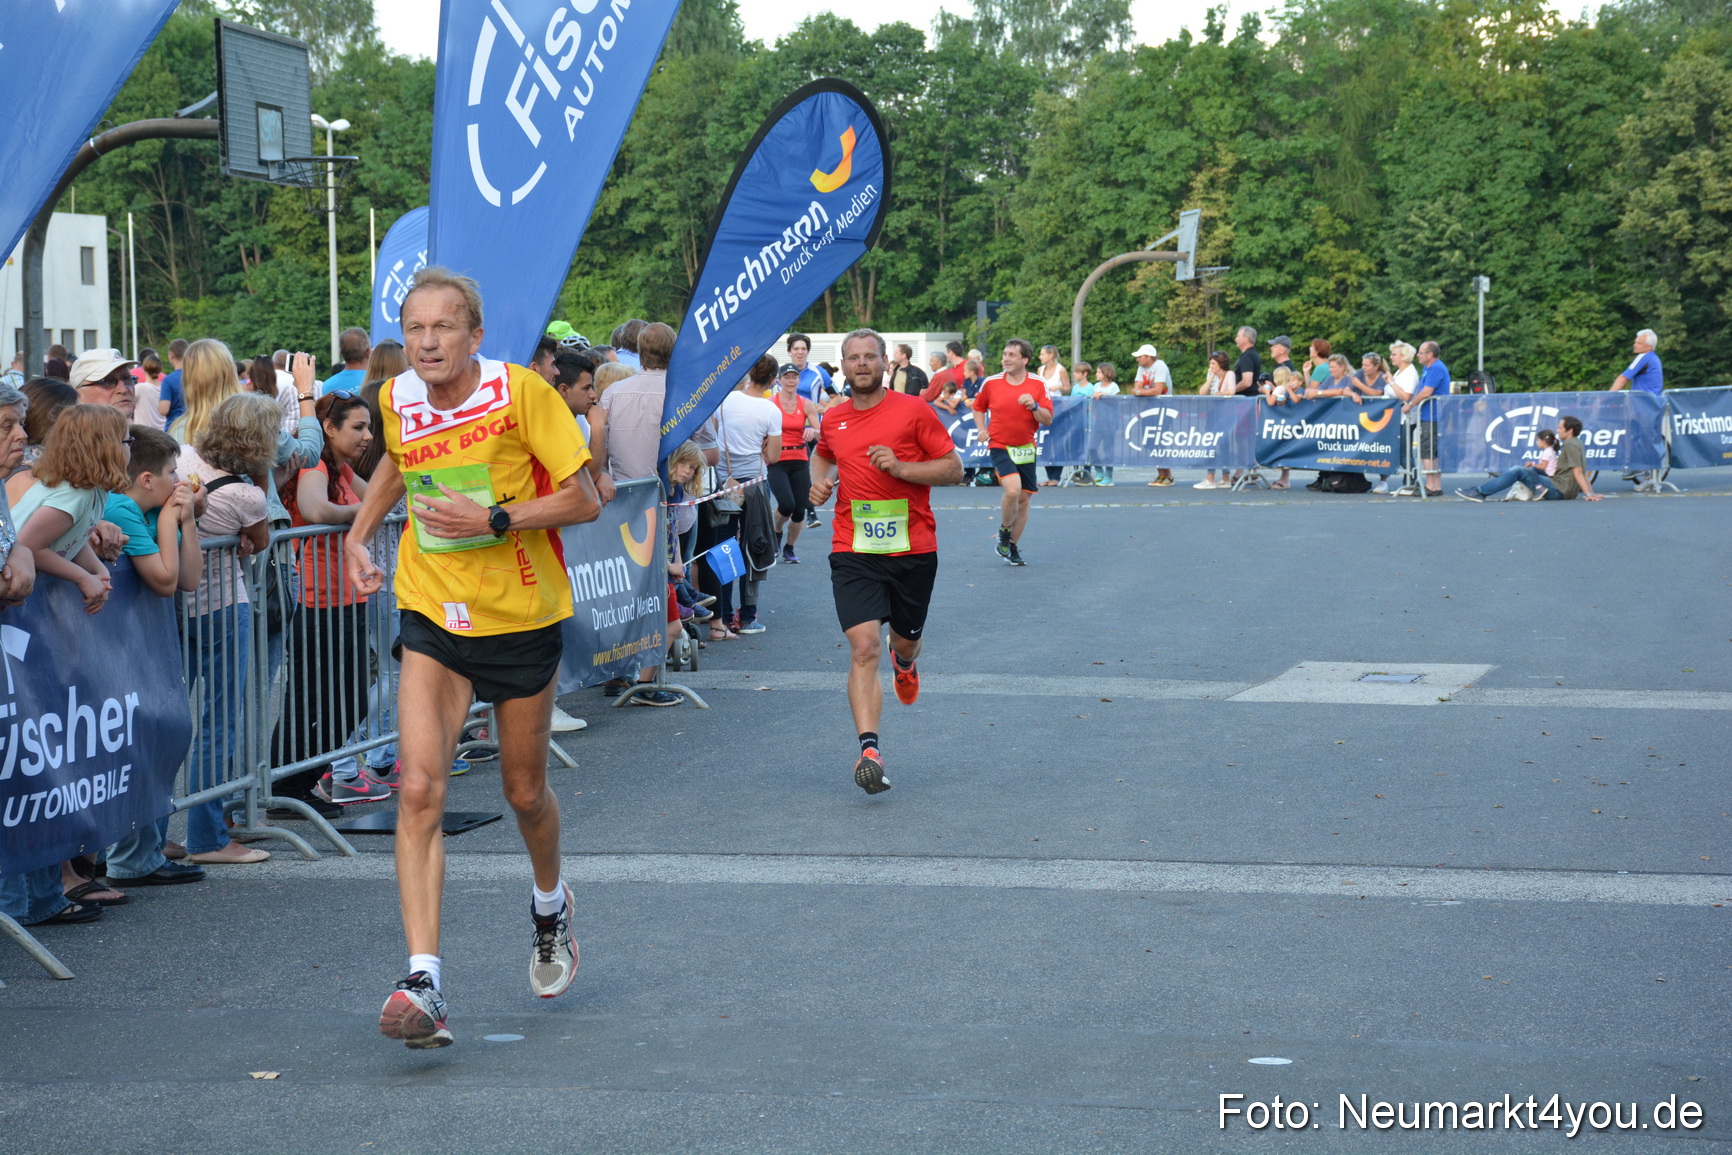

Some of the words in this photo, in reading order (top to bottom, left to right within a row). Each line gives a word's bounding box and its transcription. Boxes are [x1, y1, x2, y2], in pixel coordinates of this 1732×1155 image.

[505, 0, 599, 149] Fis
[780, 245, 815, 286] Druck
[837, 184, 878, 235] Medien
[693, 200, 830, 344] Frischmann
[402, 438, 453, 469] MAX
[459, 414, 519, 451] BÖGL
[1141, 426, 1225, 447] Fischer
[1262, 418, 1360, 441] Frischmann
[1317, 440, 1342, 452] Druck
[1357, 441, 1392, 454] Medien
[1149, 449, 1216, 459] AUTOMOBILE
[863, 520, 898, 540] 965
[591, 602, 618, 631] Druck
[617, 596, 636, 624] und
[2, 763, 132, 828] UTOMOBILE
